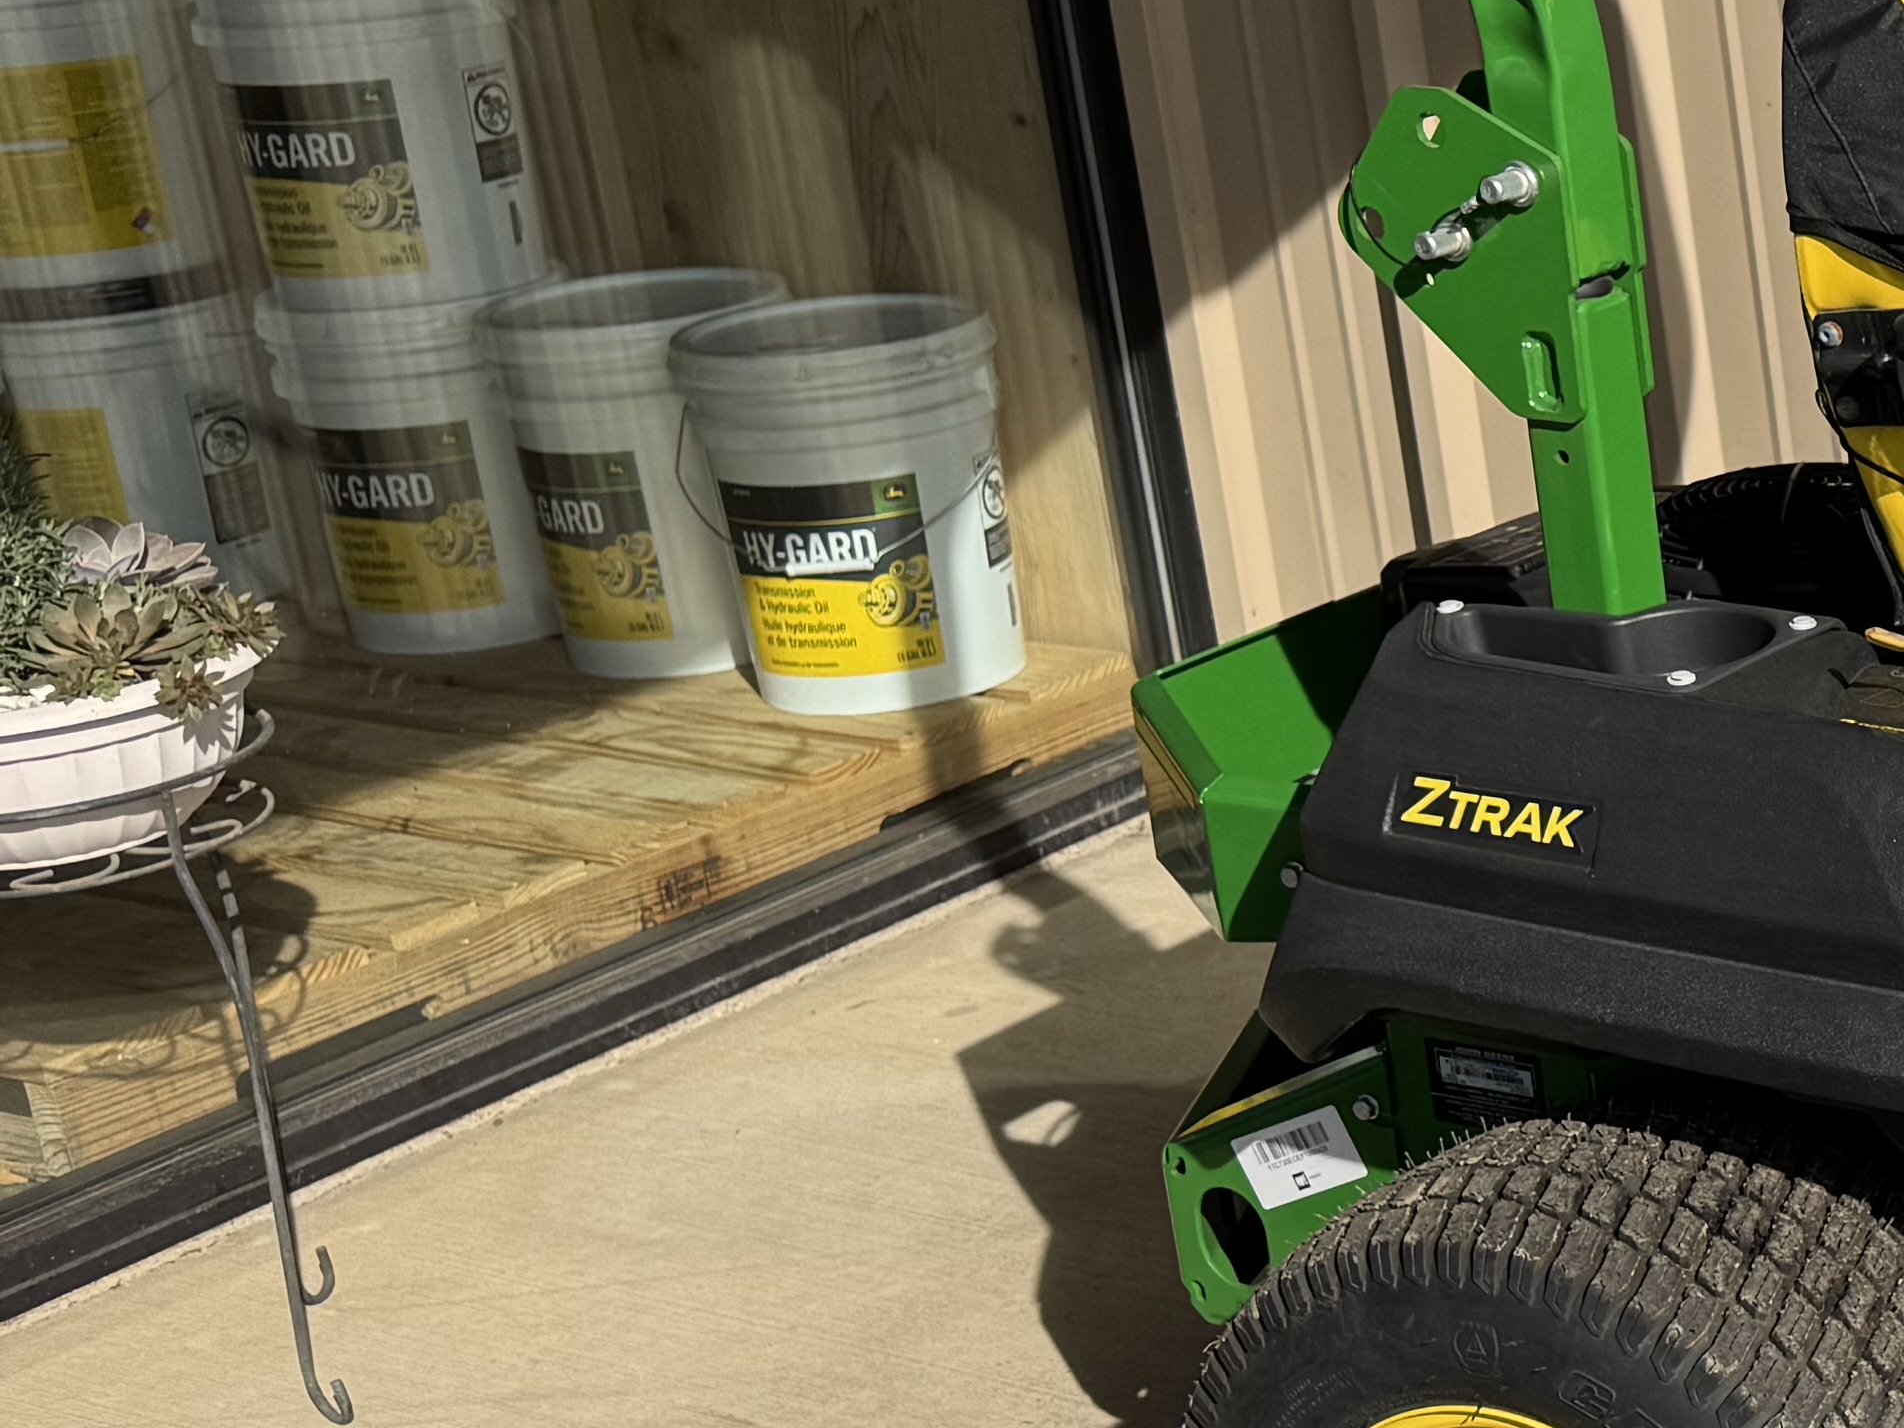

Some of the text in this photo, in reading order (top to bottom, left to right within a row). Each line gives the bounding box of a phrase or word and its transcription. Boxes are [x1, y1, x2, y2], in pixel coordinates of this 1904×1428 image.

[236, 131, 356, 169] HY-GARD
[317, 469, 436, 509] HY-GARD
[537, 494, 605, 535] GARD
[742, 527, 880, 570] HY-GARD
[1400, 775, 1585, 848] ZTRAK
